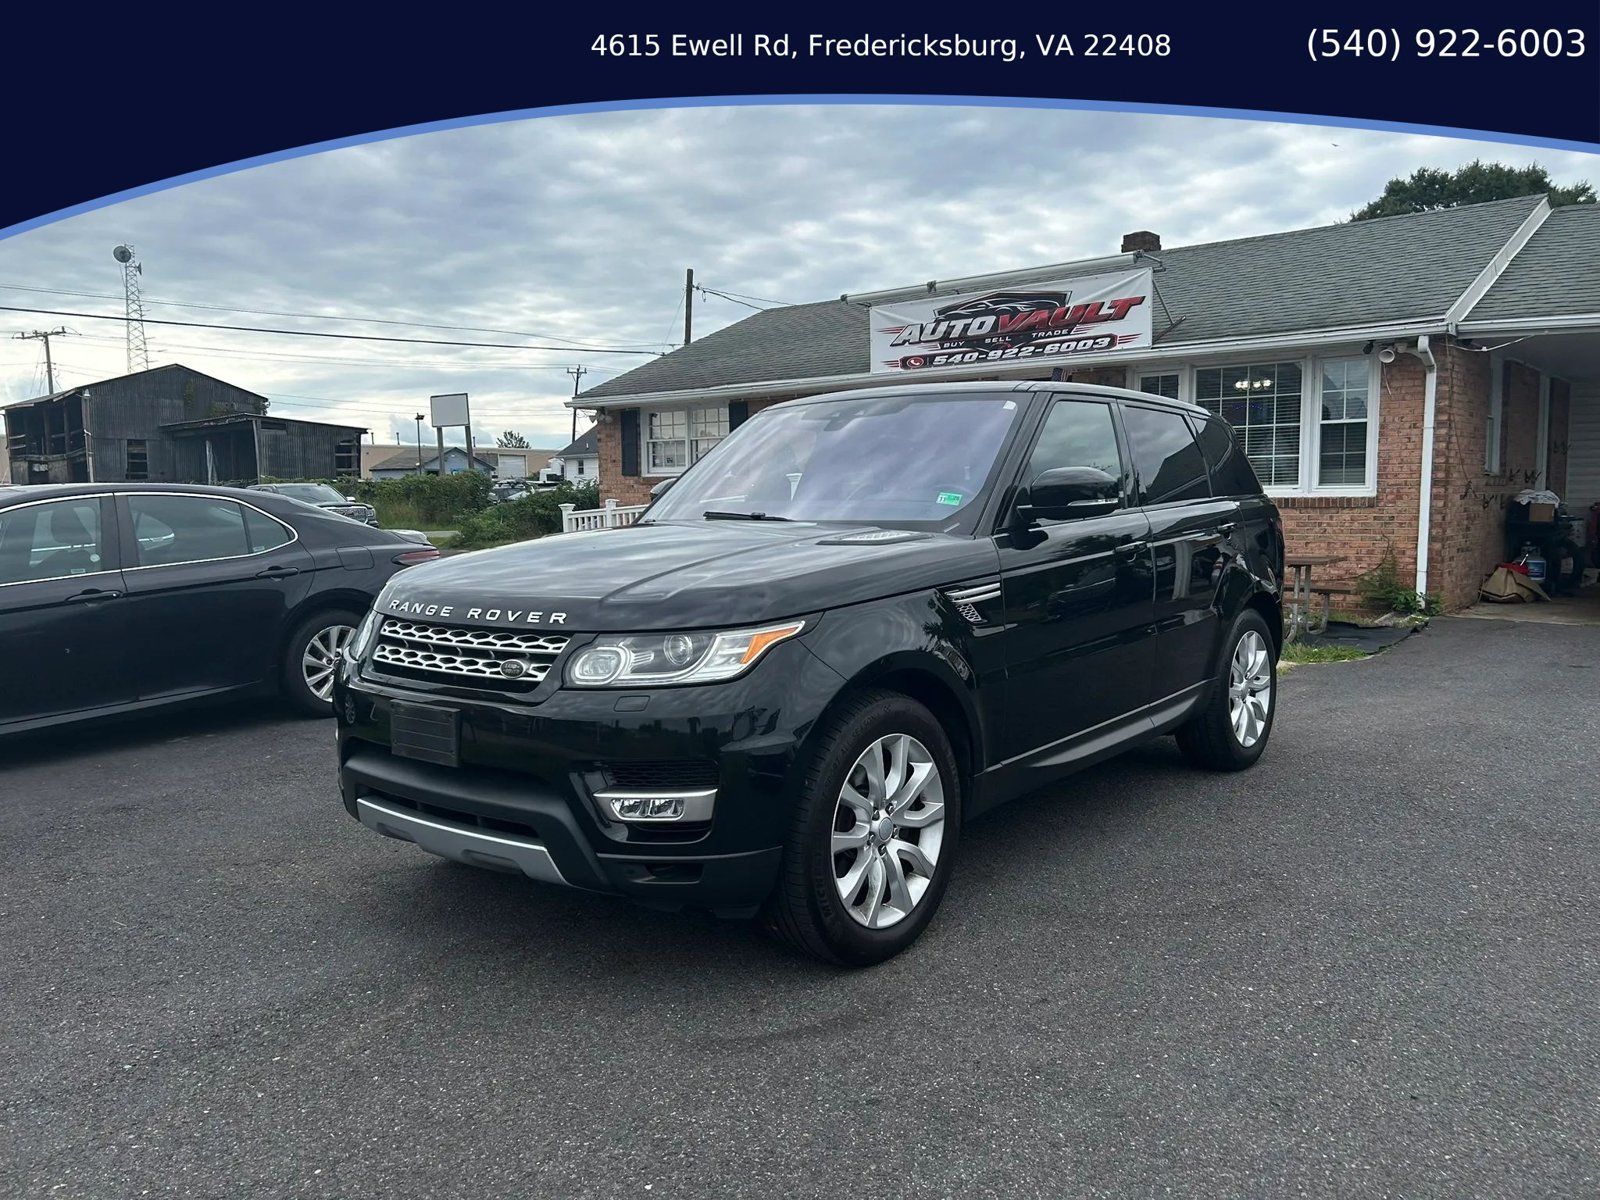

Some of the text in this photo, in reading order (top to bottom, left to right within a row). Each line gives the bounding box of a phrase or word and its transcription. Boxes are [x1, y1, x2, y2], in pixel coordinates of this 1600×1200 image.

[984, 336, 1012, 344] SELL
[1031, 328, 1069, 338] TRADE
[932, 337, 1112, 365] 540-922-6003
[389, 599, 567, 624] RANGE ROVER
